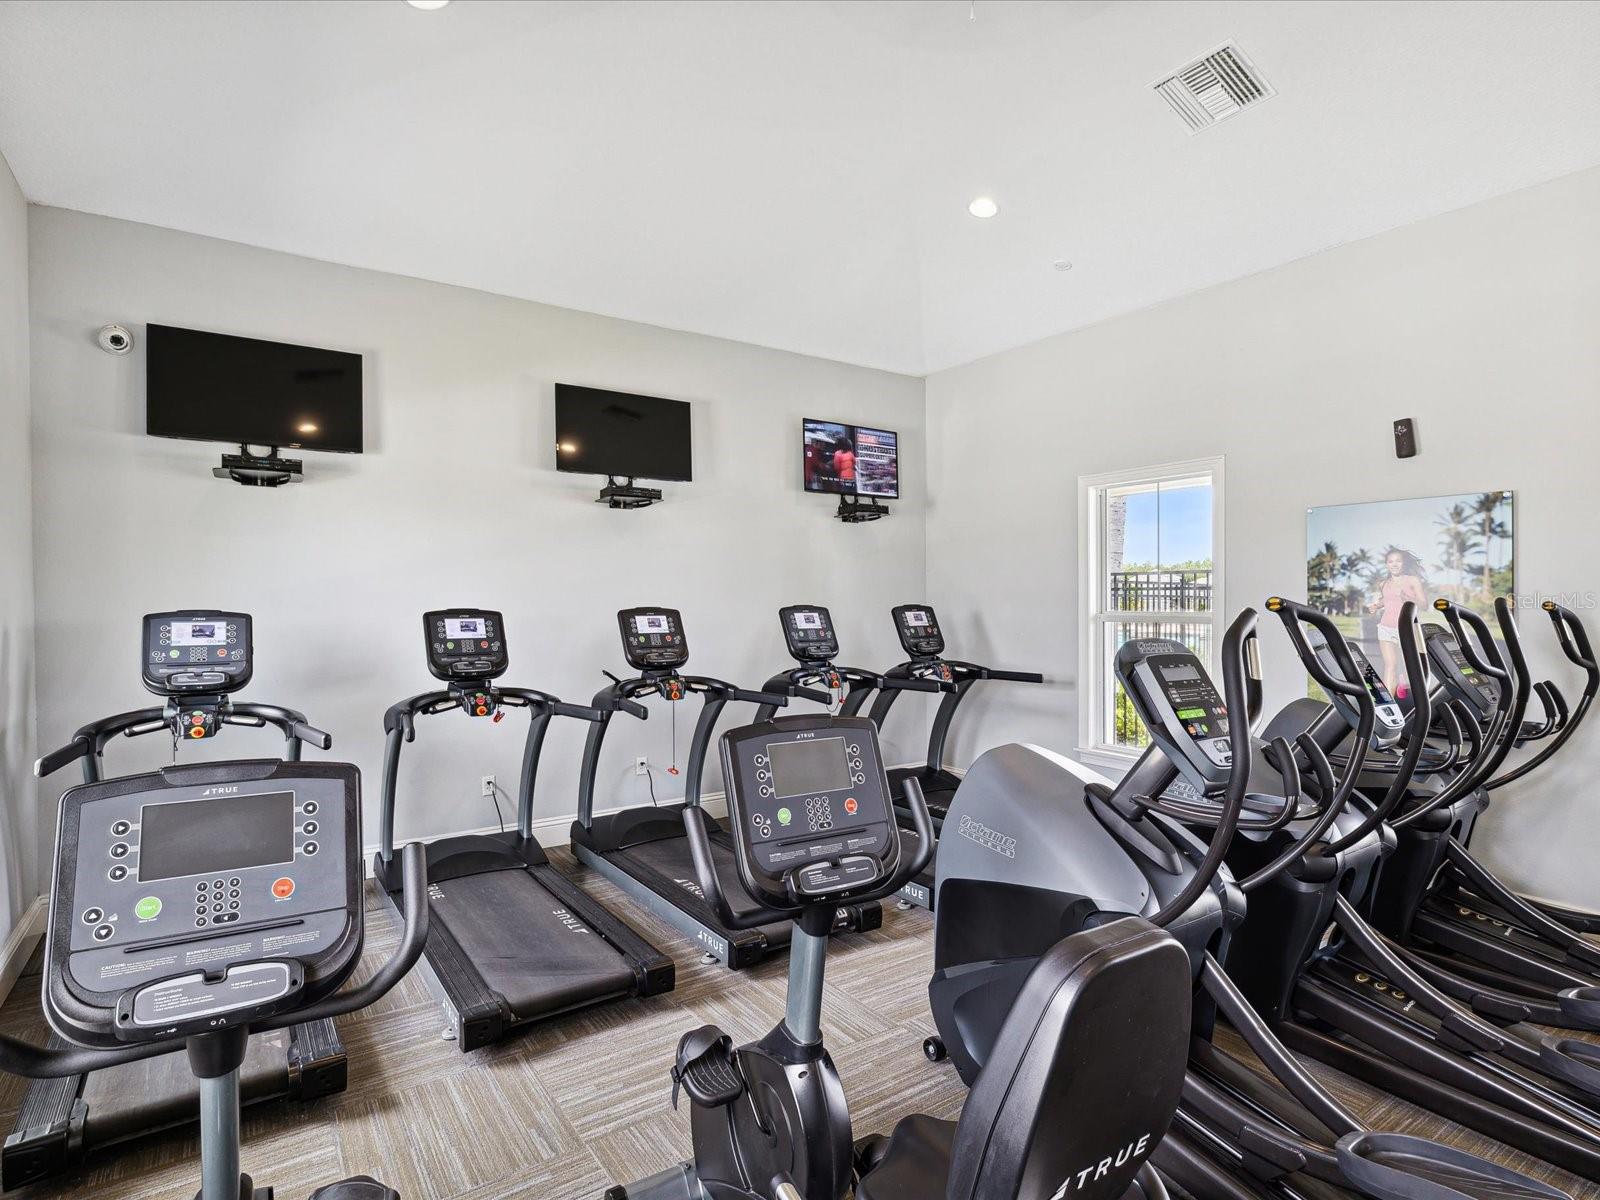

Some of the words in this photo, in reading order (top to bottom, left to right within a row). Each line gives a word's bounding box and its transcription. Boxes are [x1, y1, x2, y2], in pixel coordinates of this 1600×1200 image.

[212, 786, 239, 795] TRUE
[959, 814, 1016, 849] Octane
[900, 885, 924, 900] RUE
[552, 909, 581, 930] TRUE
[702, 931, 724, 954] TRUE
[1076, 1133, 1151, 1190] TRUE
